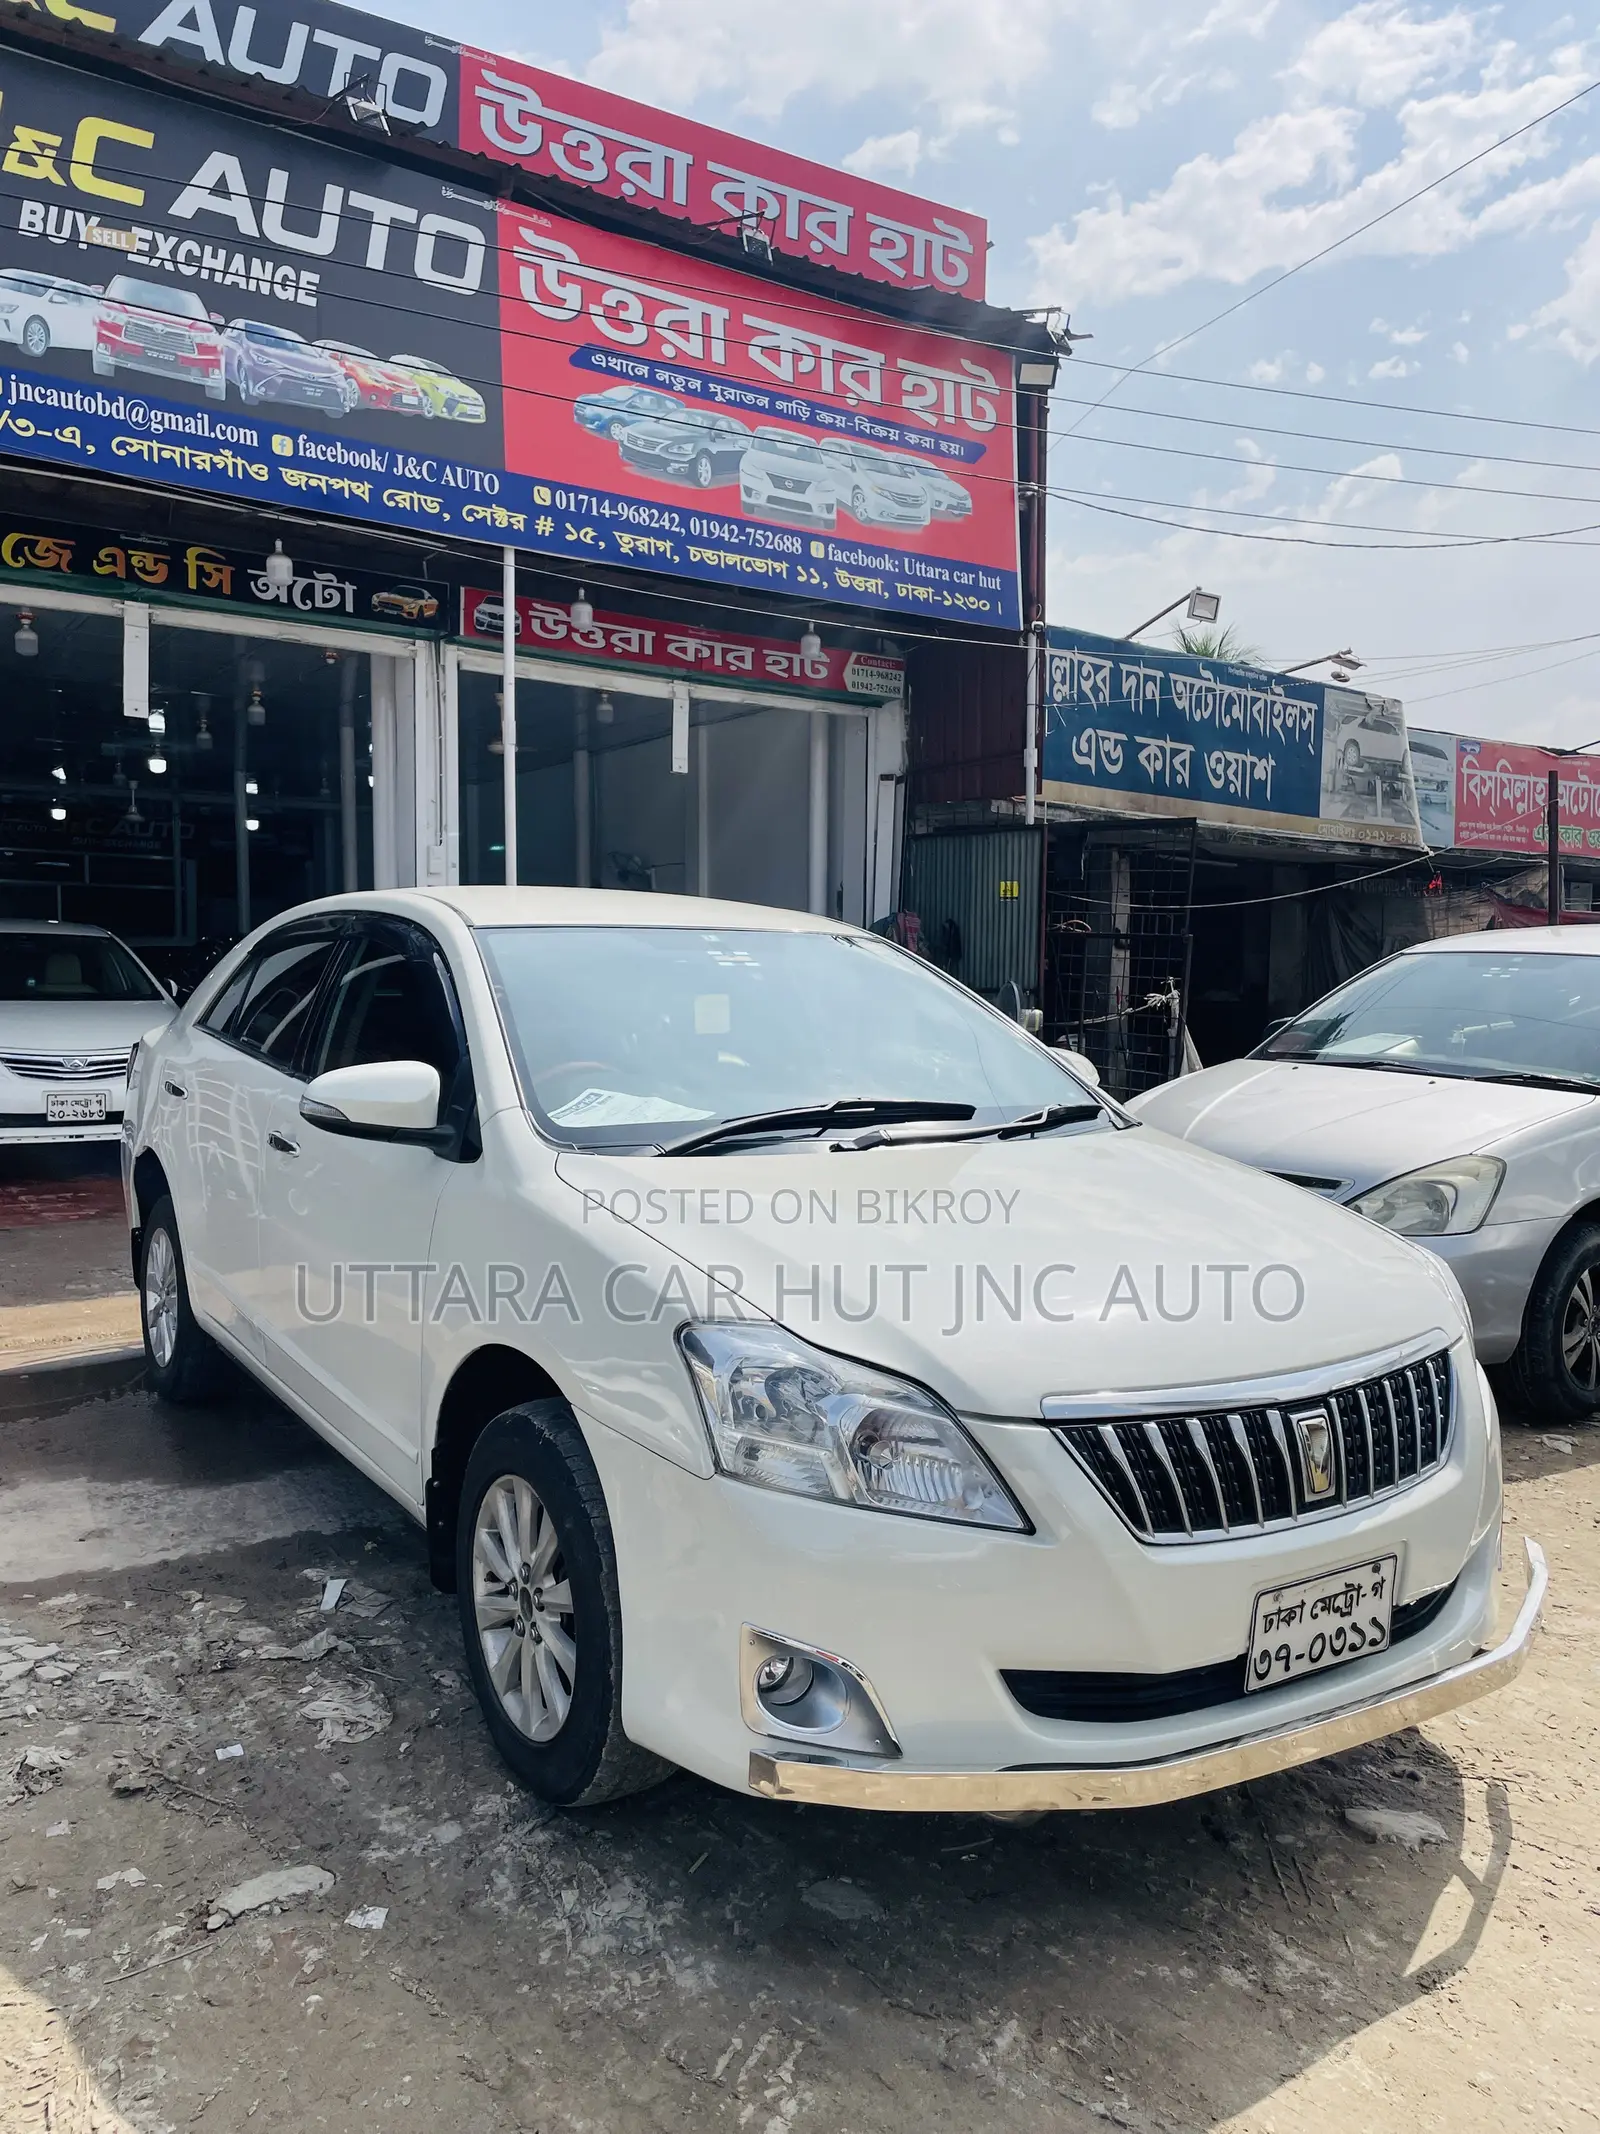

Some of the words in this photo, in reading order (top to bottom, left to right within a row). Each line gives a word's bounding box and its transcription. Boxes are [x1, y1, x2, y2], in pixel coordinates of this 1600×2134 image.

[137, 0, 448, 128] AUTO
[475, 68, 694, 206] উত্তরা
[706, 160, 855, 257] কার
[865, 212, 974, 287] হাট
[18, 199, 101, 250] BUY
[91, 227, 131, 249] SELL
[127, 225, 321, 307] EXCHANGE
[167, 150, 486, 296] AUTO
[513, 226, 730, 365] উত্তরা
[742, 313, 886, 407] কার
[897, 357, 1000, 432] হাট
[8, 374, 259, 447] jncautobd@gmail.com
[591, 353, 649, 379] এখানে
[654, 368, 702, 392] নতুন
[708, 382, 769, 410] পুরাতন
[775, 399, 811, 421] গাড়ি
[904, 431, 935, 450] করা
[297, 433, 389, 473] facebook/
[392, 453, 437, 483] J&C
[441, 464, 500, 495] AUTO
[111, 435, 269, 482] সোনারগাঁও
[278, 466, 374, 503] জনপথ
[383, 488, 451, 522] রোড,
[534, 515, 555, 537] #
[564, 522, 606, 550] ১৫,
[612, 531, 680, 564] তুরাগ,
[834, 567, 889, 600] উত্তরা,
[555, 489, 686, 537] 01714-968242,
[690, 517, 802, 556] 01942-752688
[828, 543, 900, 573] facebook:
[903, 557, 949, 582] Uttara
[953, 572, 976, 586] car
[979, 571, 1002, 591] hut
[1, 532, 76, 573] জে
[92, 546, 171, 585] এন্ড
[183, 546, 236, 595] সি
[247, 567, 357, 614] অটো
[529, 602, 656, 656] উত্তরা
[664, 633, 755, 672] কার
[1120, 660, 1165, 718] দান
[1072, 727, 1128, 776] এন্ড
[1134, 734, 1196, 789] কার
[1204, 749, 1276, 801] ওয়াশ
[1254, 1616, 1387, 1681] ৩৭-০৩১১
[1262, 1599, 1306, 1634] ঢাকা
[1371, 1576, 1387, 1599] গ
